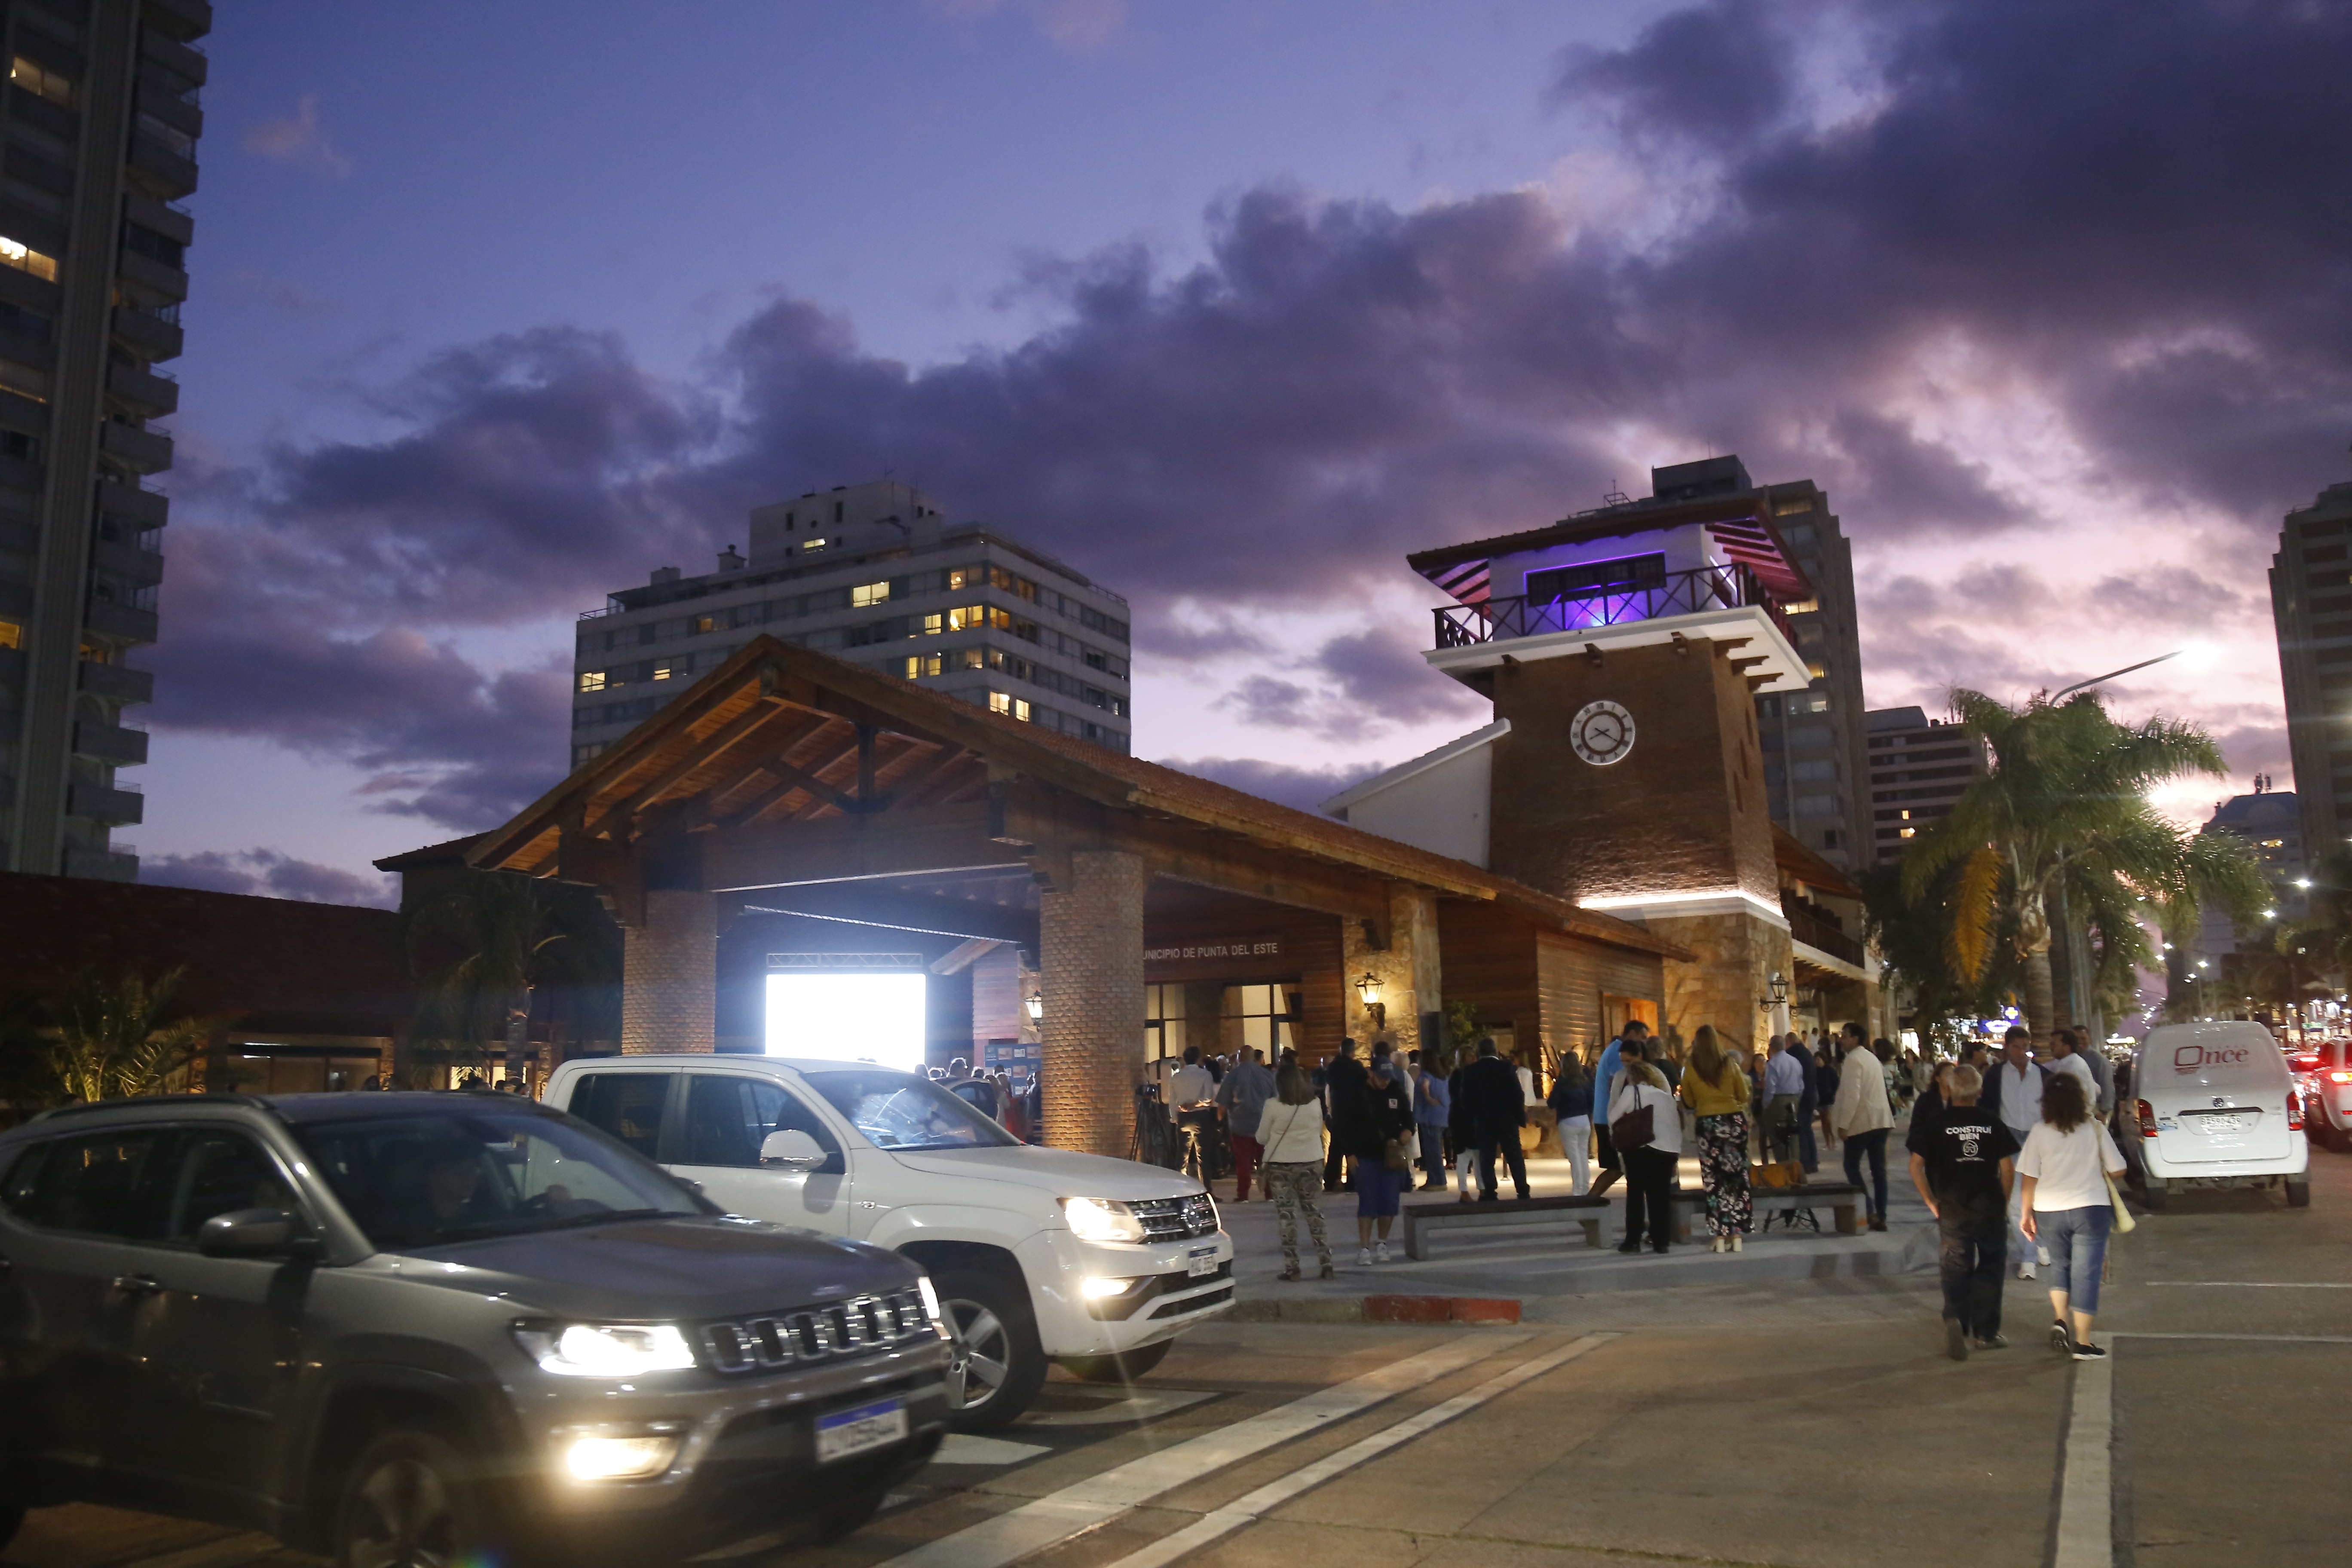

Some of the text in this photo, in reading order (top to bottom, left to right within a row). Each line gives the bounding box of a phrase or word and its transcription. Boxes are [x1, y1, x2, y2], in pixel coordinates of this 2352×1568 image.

[1143, 943, 1278, 960] UNICIPIO DE PUNTA DEL ESTE
